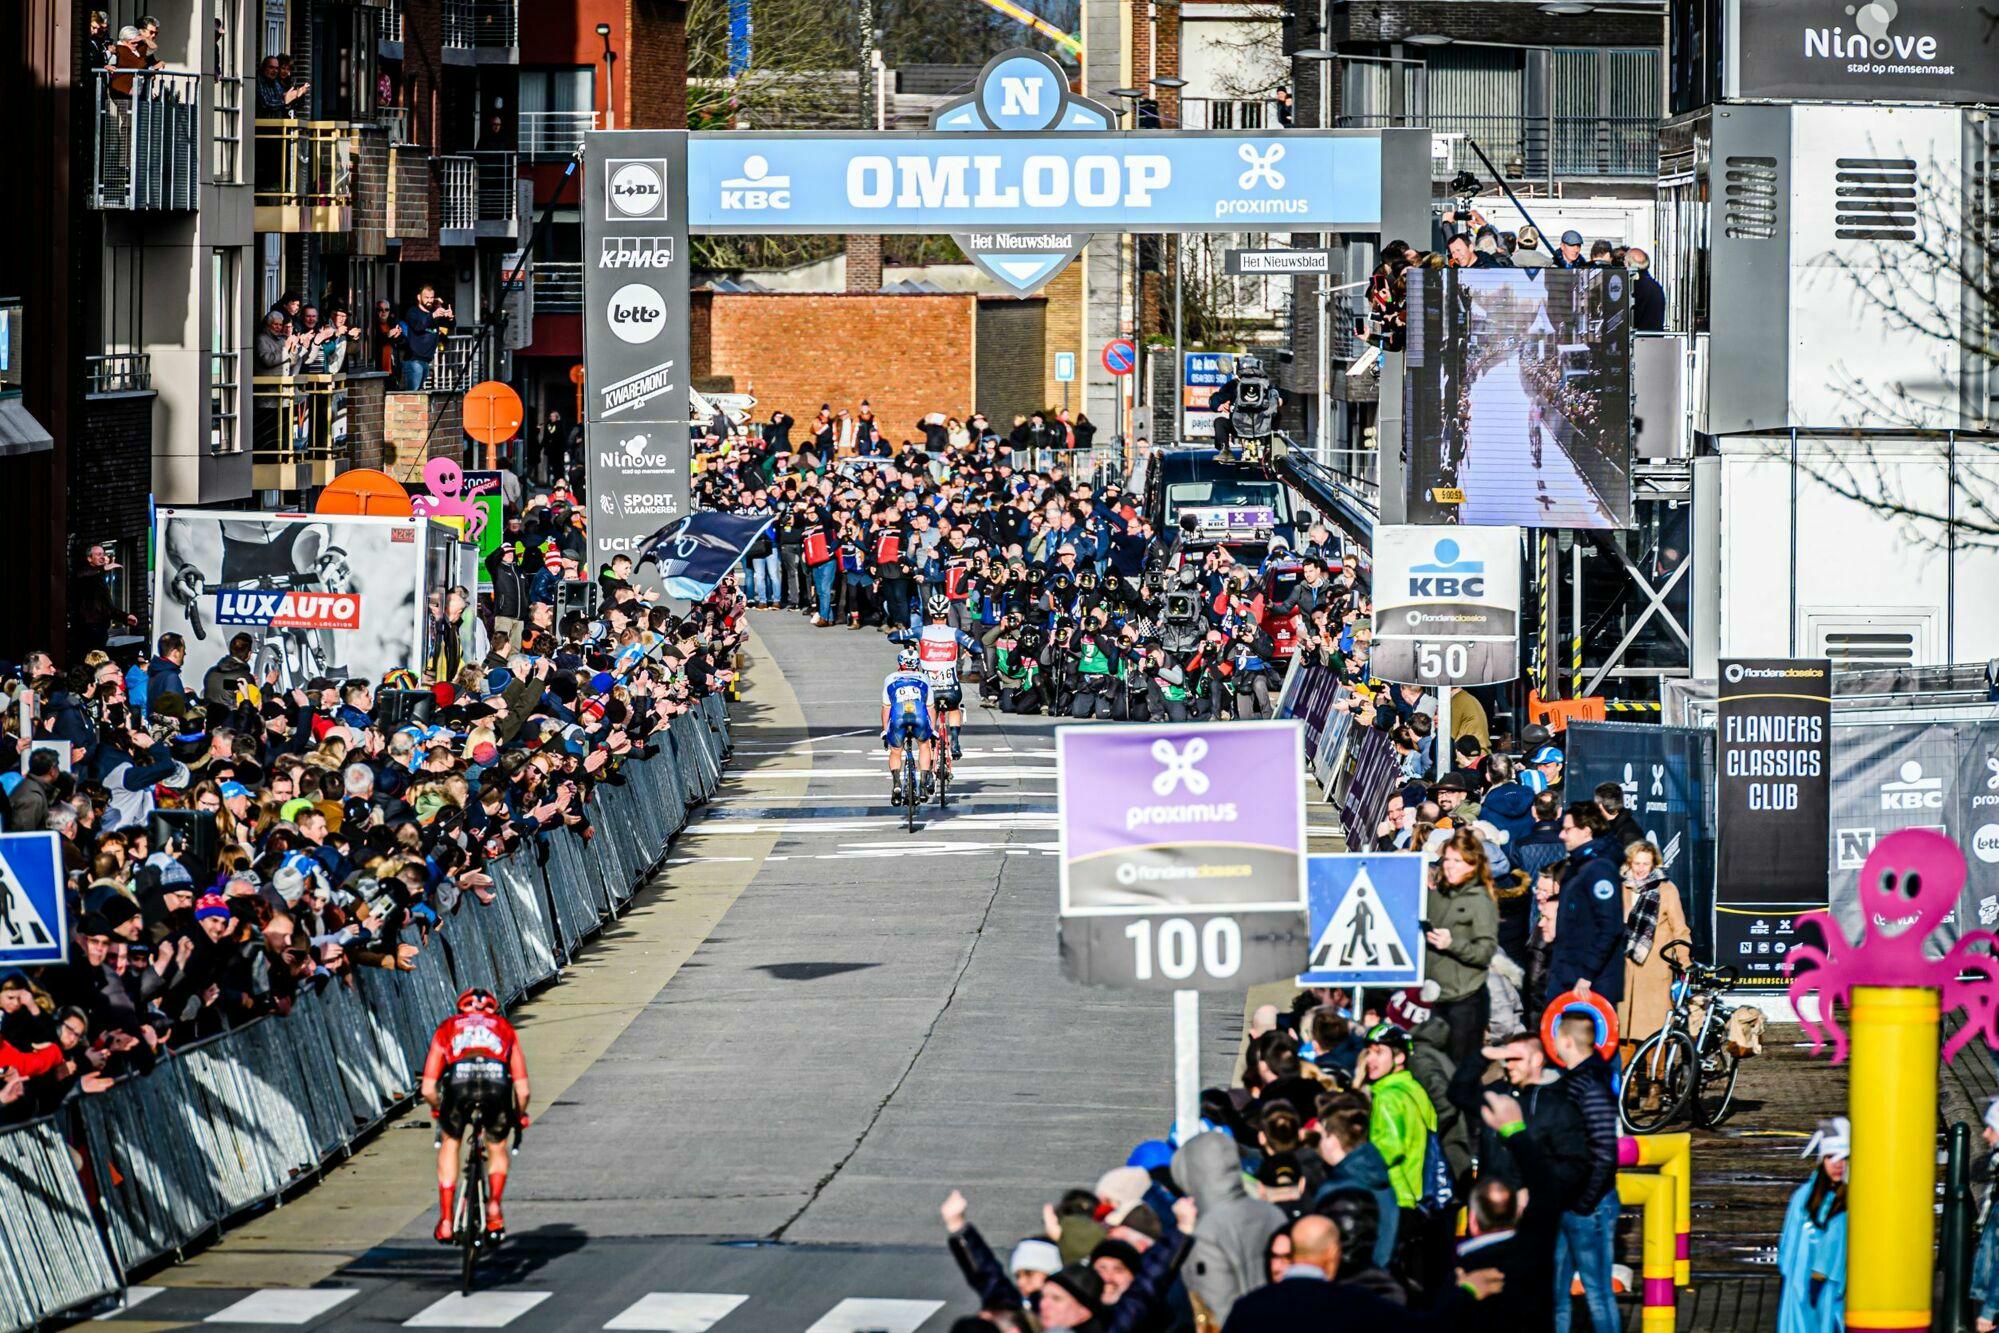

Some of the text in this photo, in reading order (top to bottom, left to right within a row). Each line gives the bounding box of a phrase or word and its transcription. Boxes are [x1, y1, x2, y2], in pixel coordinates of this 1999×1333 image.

[1805, 27, 1937, 60] Ninove
[1847, 63, 1955, 75] stad op mensenmaat
[1001, 77, 1043, 116] N
[846, 155, 1172, 208] OMLOOP
[721, 190, 790, 210] KBC
[1215, 199, 1309, 218] proximus
[970, 233, 1073, 249] Het Nieuwsblad
[599, 249, 671, 269] KPMG
[1243, 255, 1326, 268] Het Nieuwsblad
[605, 369, 669, 409] KWAREMONT
[600, 451, 667, 468] Ninove
[624, 494, 678, 506] SPORT.
[624, 506, 677, 514] VLAANDEREN
[599, 537, 630, 551] UCI
[1409, 577, 1485, 597] KBC
[220, 593, 355, 620] LUXAUTO
[1420, 643, 1468, 679] 50
[1744, 668, 1824, 678] flandersclassics
[1726, 715, 1822, 743] FLANDERS
[1726, 750, 1821, 777] CLASSICS
[1623, 793, 1638, 811] BC
[1749, 783, 1798, 810] CLUB
[1881, 791, 1943, 810] KBC
[1126, 802, 1239, 830] proximus
[1841, 831, 1871, 861] N
[1125, 917, 1242, 980] 100
